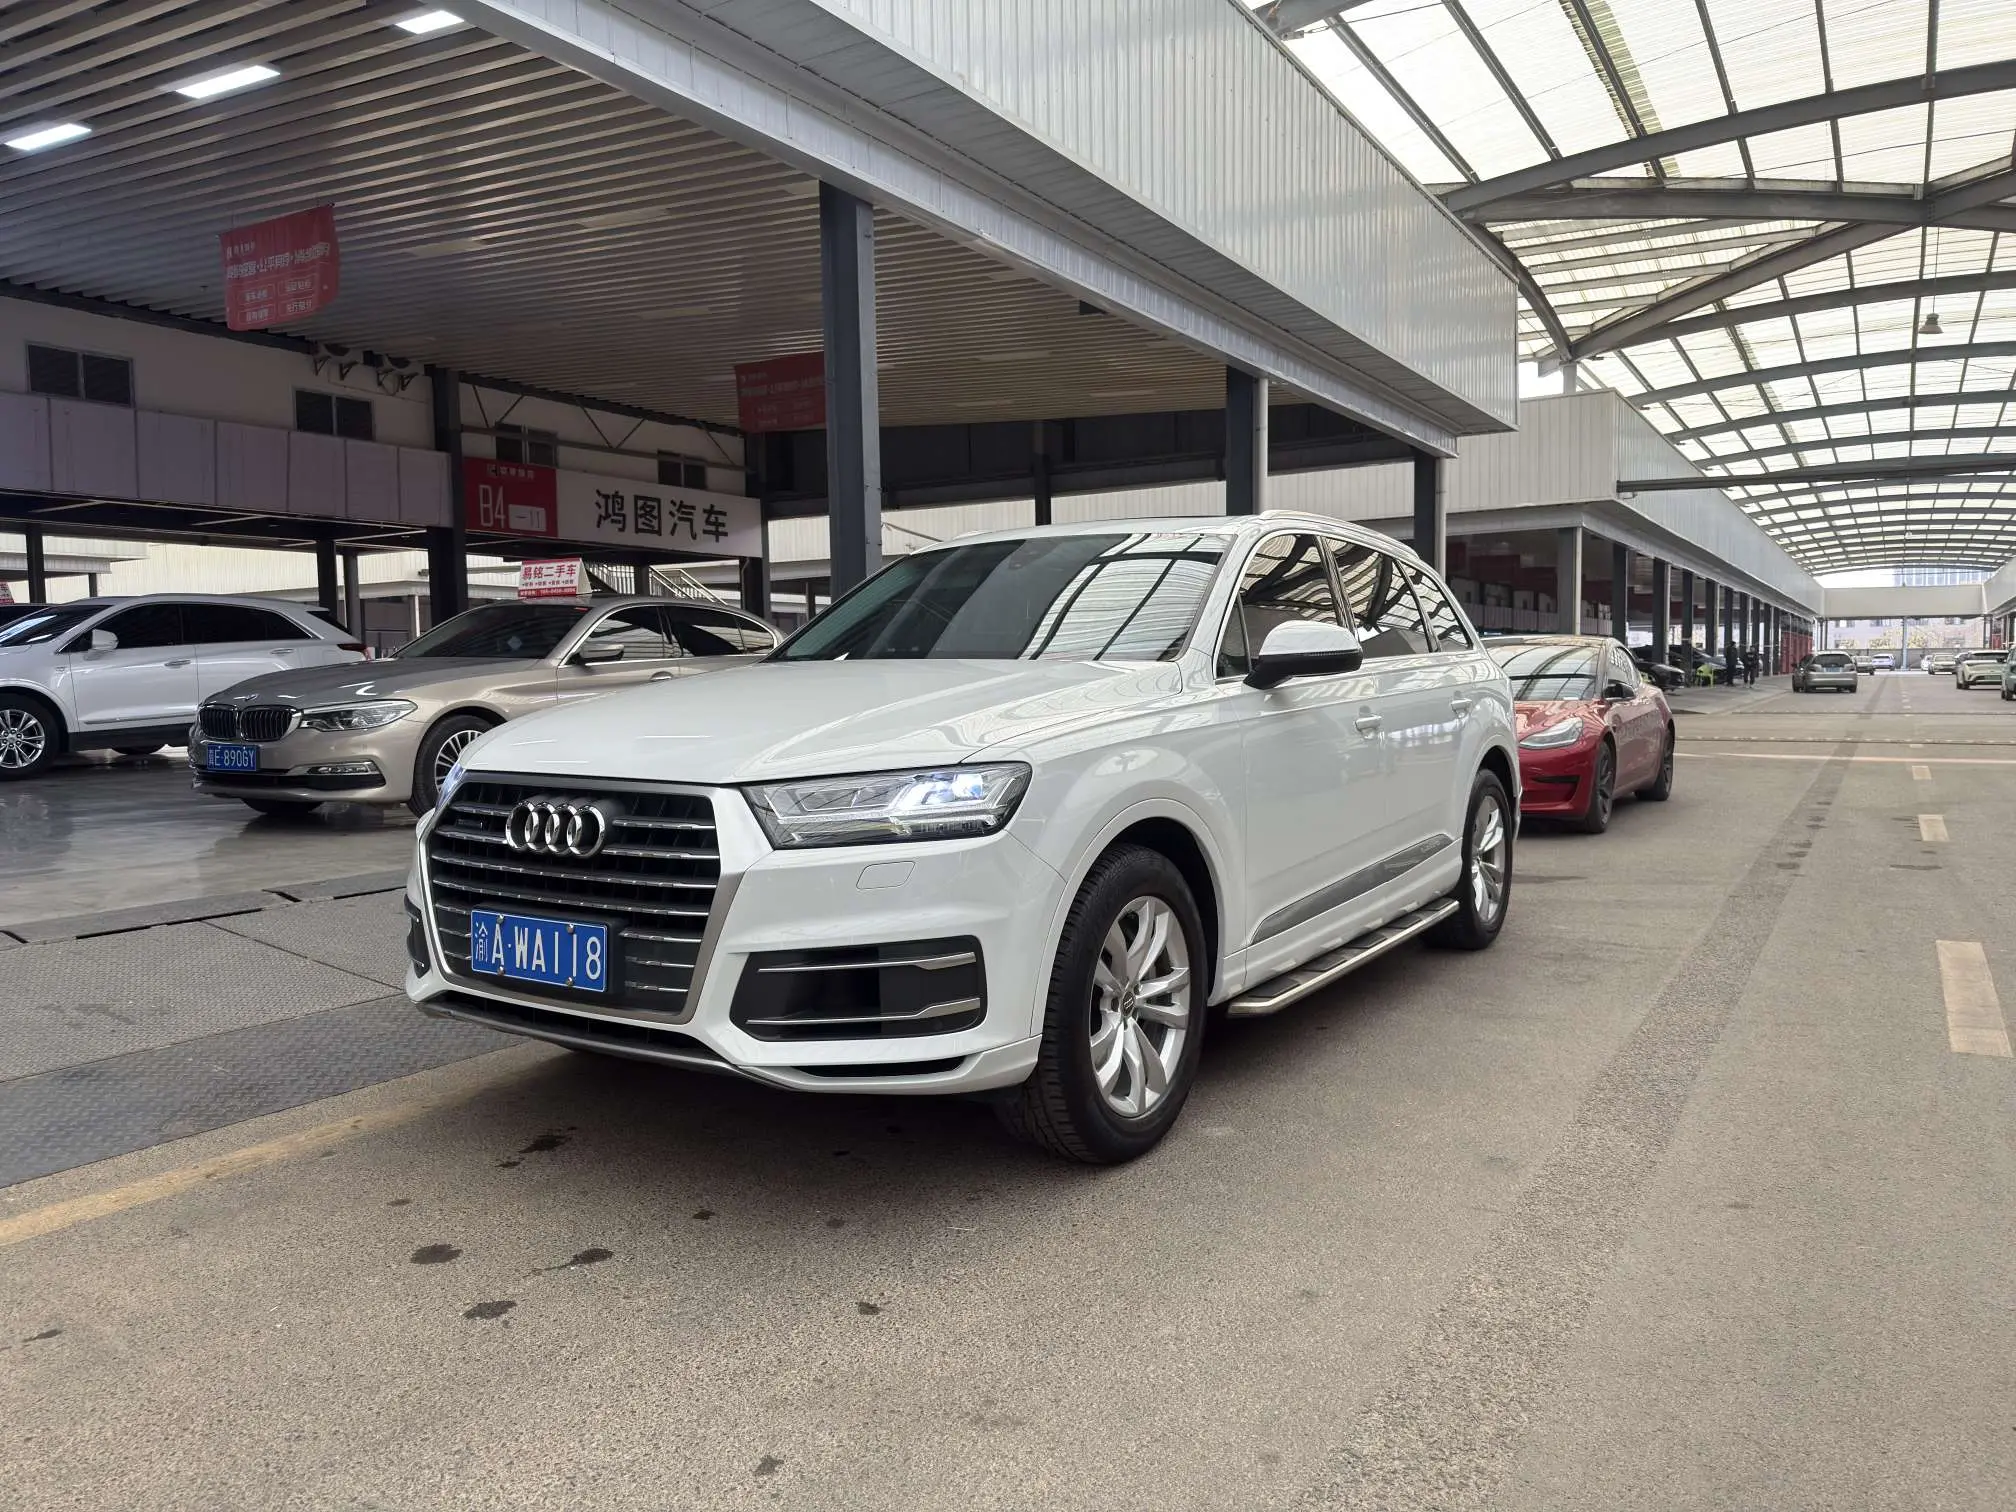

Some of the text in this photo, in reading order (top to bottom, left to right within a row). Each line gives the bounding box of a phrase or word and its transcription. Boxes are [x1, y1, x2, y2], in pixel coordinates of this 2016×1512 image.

[479, 484, 505, 528] B4
[595, 489, 729, 543] 鸿图汽车
